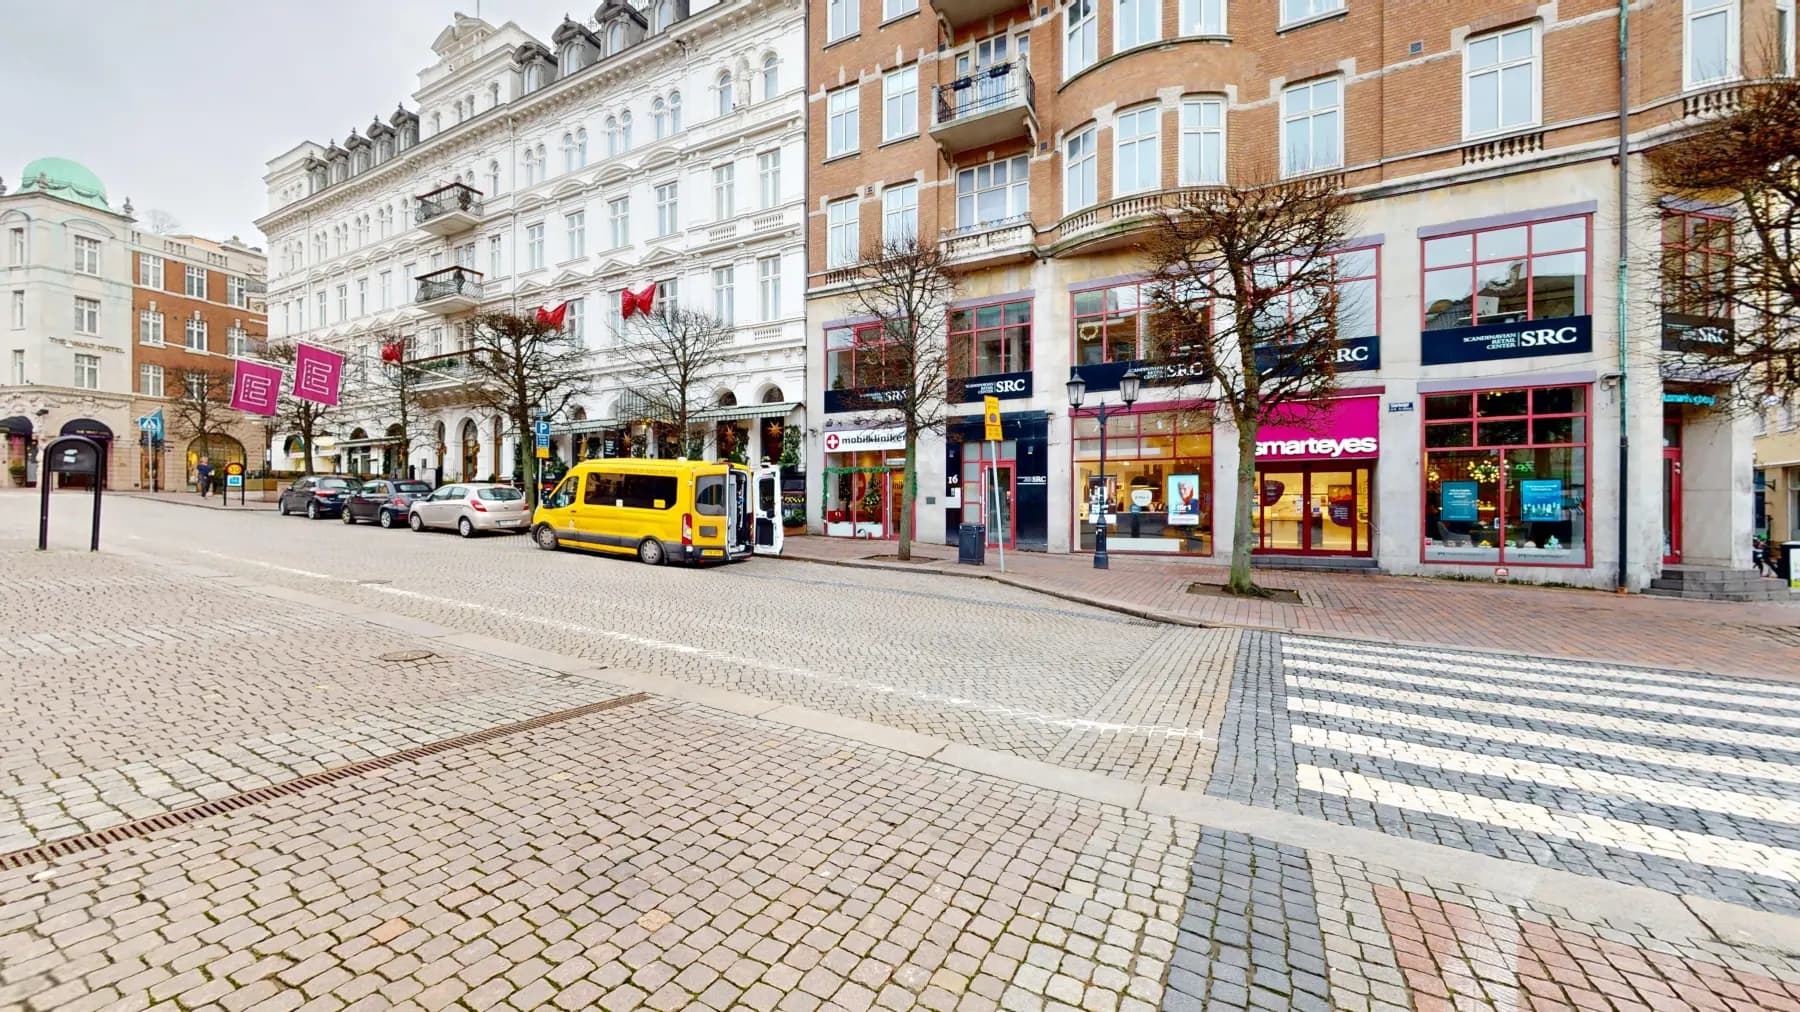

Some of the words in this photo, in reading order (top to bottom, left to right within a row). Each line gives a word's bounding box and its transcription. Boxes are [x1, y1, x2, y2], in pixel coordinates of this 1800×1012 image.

[1463, 333, 1516, 343] SCANDINAVIAN
[1521, 327, 1577, 347] SRC
[1325, 346, 1369, 363] RC
[301, 358, 332, 395] E
[240, 373, 271, 406] E
[996, 379, 1025, 393] SRC
[540, 423, 548, 434] P
[1255, 437, 1377, 457] smarteyes
[948, 475, 959, 484] 16
